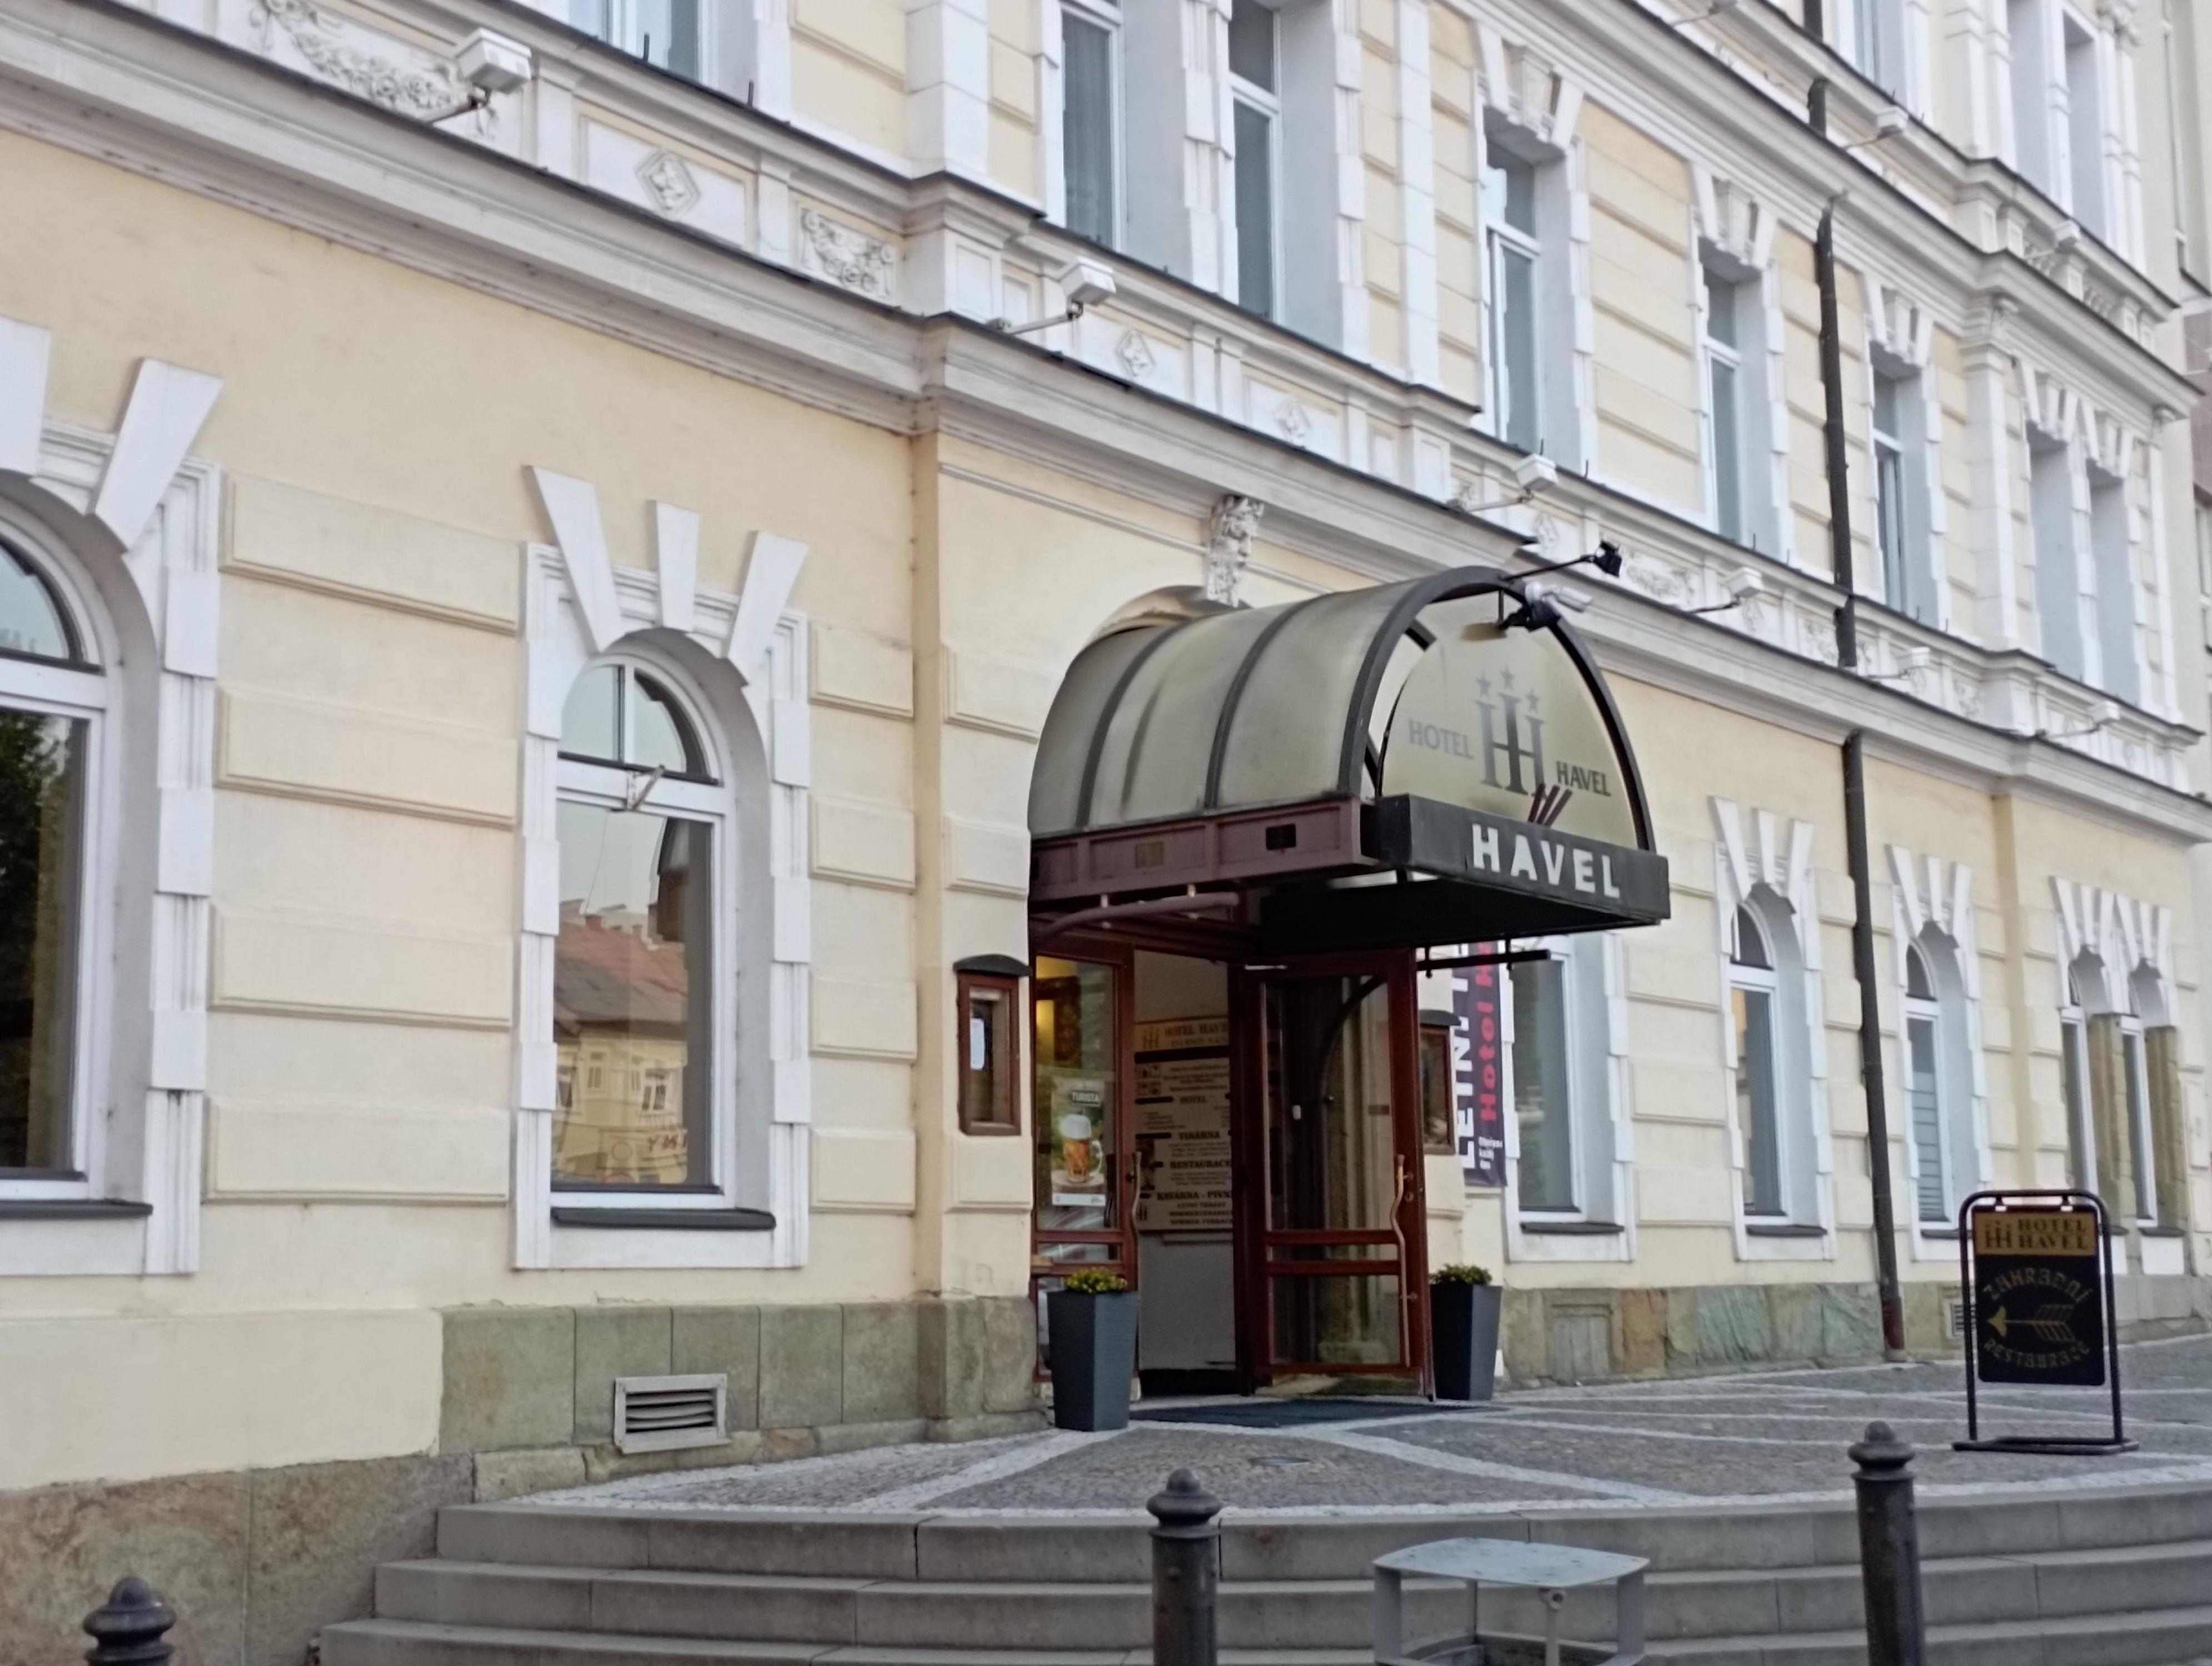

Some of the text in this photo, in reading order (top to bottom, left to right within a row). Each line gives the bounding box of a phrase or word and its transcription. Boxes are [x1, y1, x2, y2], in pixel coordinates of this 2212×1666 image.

[1409, 719, 1474, 760] HOTEL
[1556, 761, 1611, 796] HAVEL
[1471, 824, 1620, 898] HAVEL
[1477, 1001, 1496, 1121] Hotel
[2018, 1218, 2086, 1232] HOTEL
[2019, 1235, 2088, 1250] HAVEL
